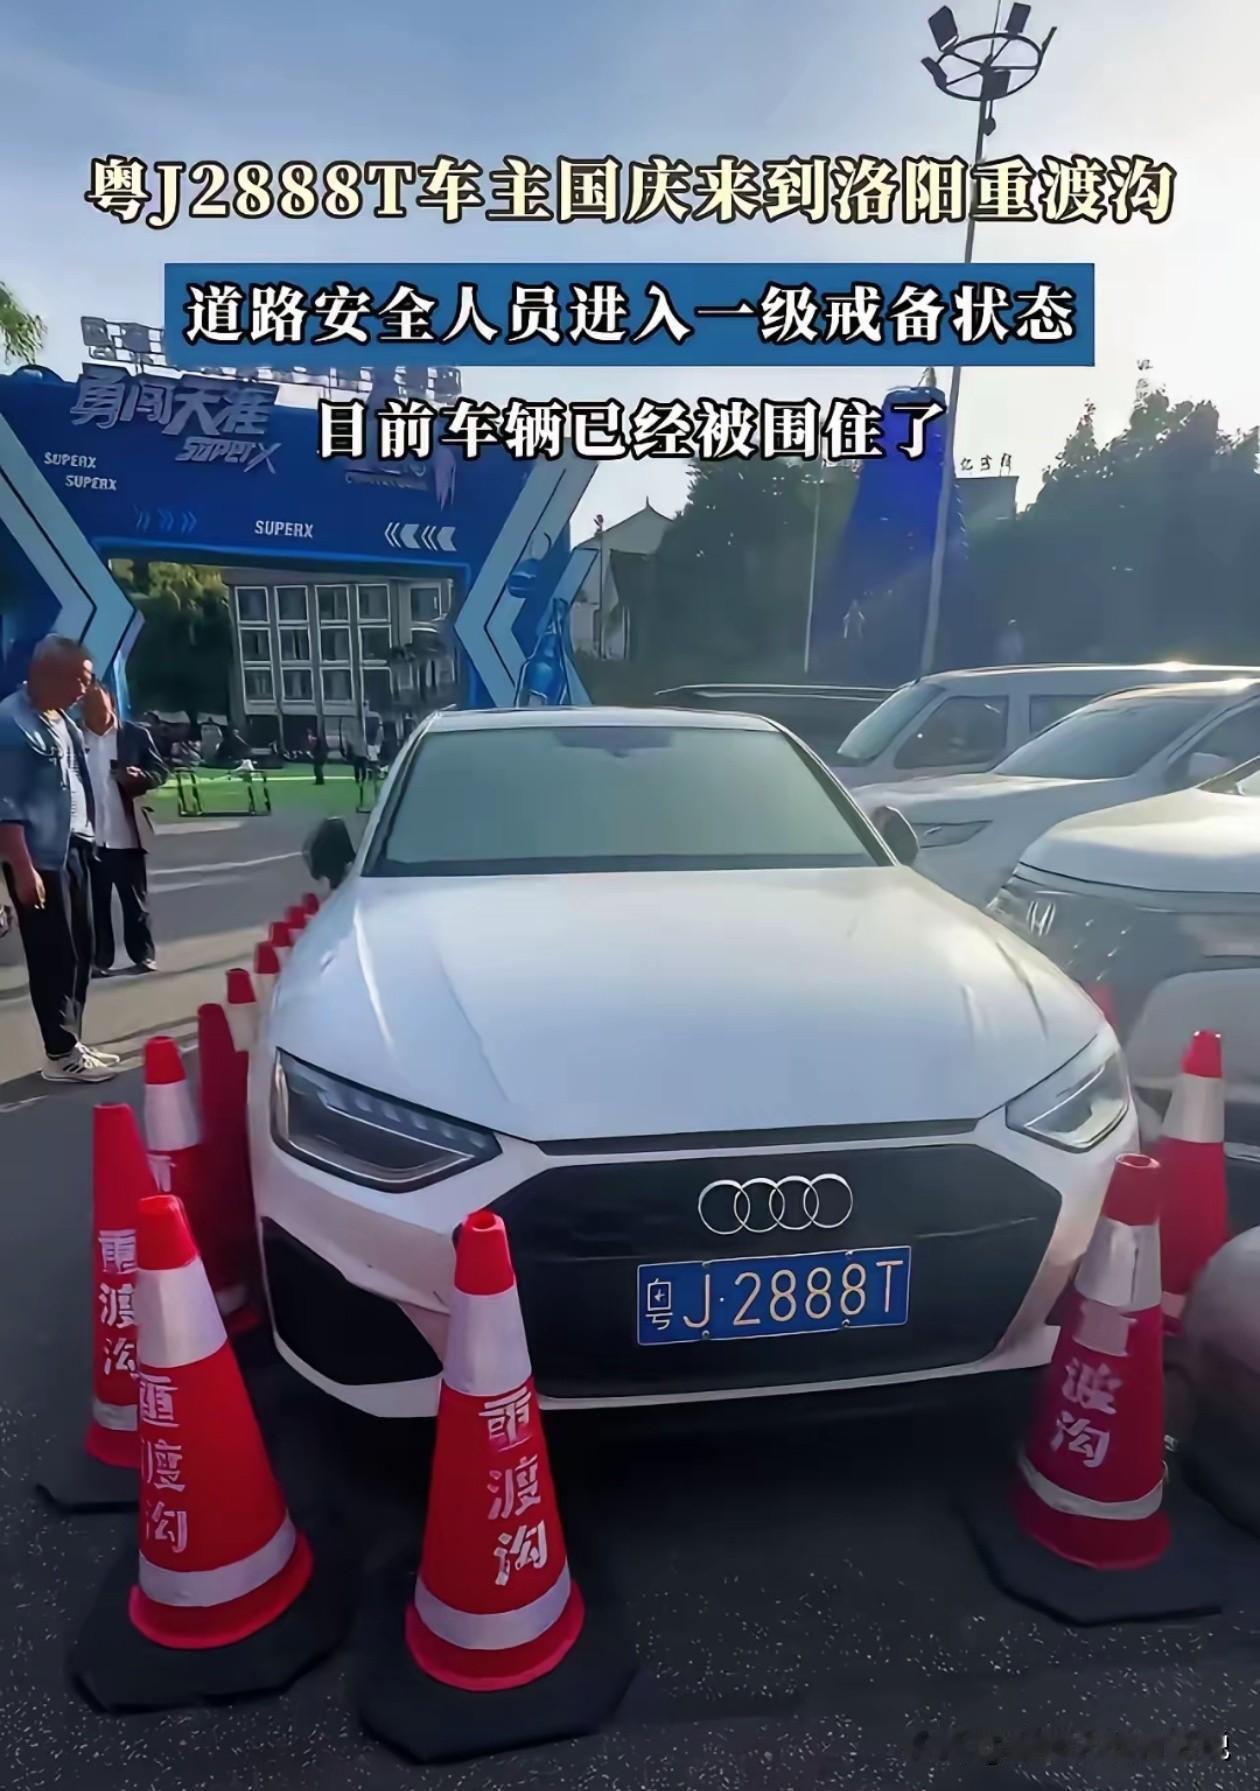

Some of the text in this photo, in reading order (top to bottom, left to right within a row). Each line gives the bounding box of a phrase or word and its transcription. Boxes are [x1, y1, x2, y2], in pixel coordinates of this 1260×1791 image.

[69, 373, 270, 437] 勇闯天涯
[65, 475, 117, 491] SUPERX
[255, 520, 313, 539] SUPERX
